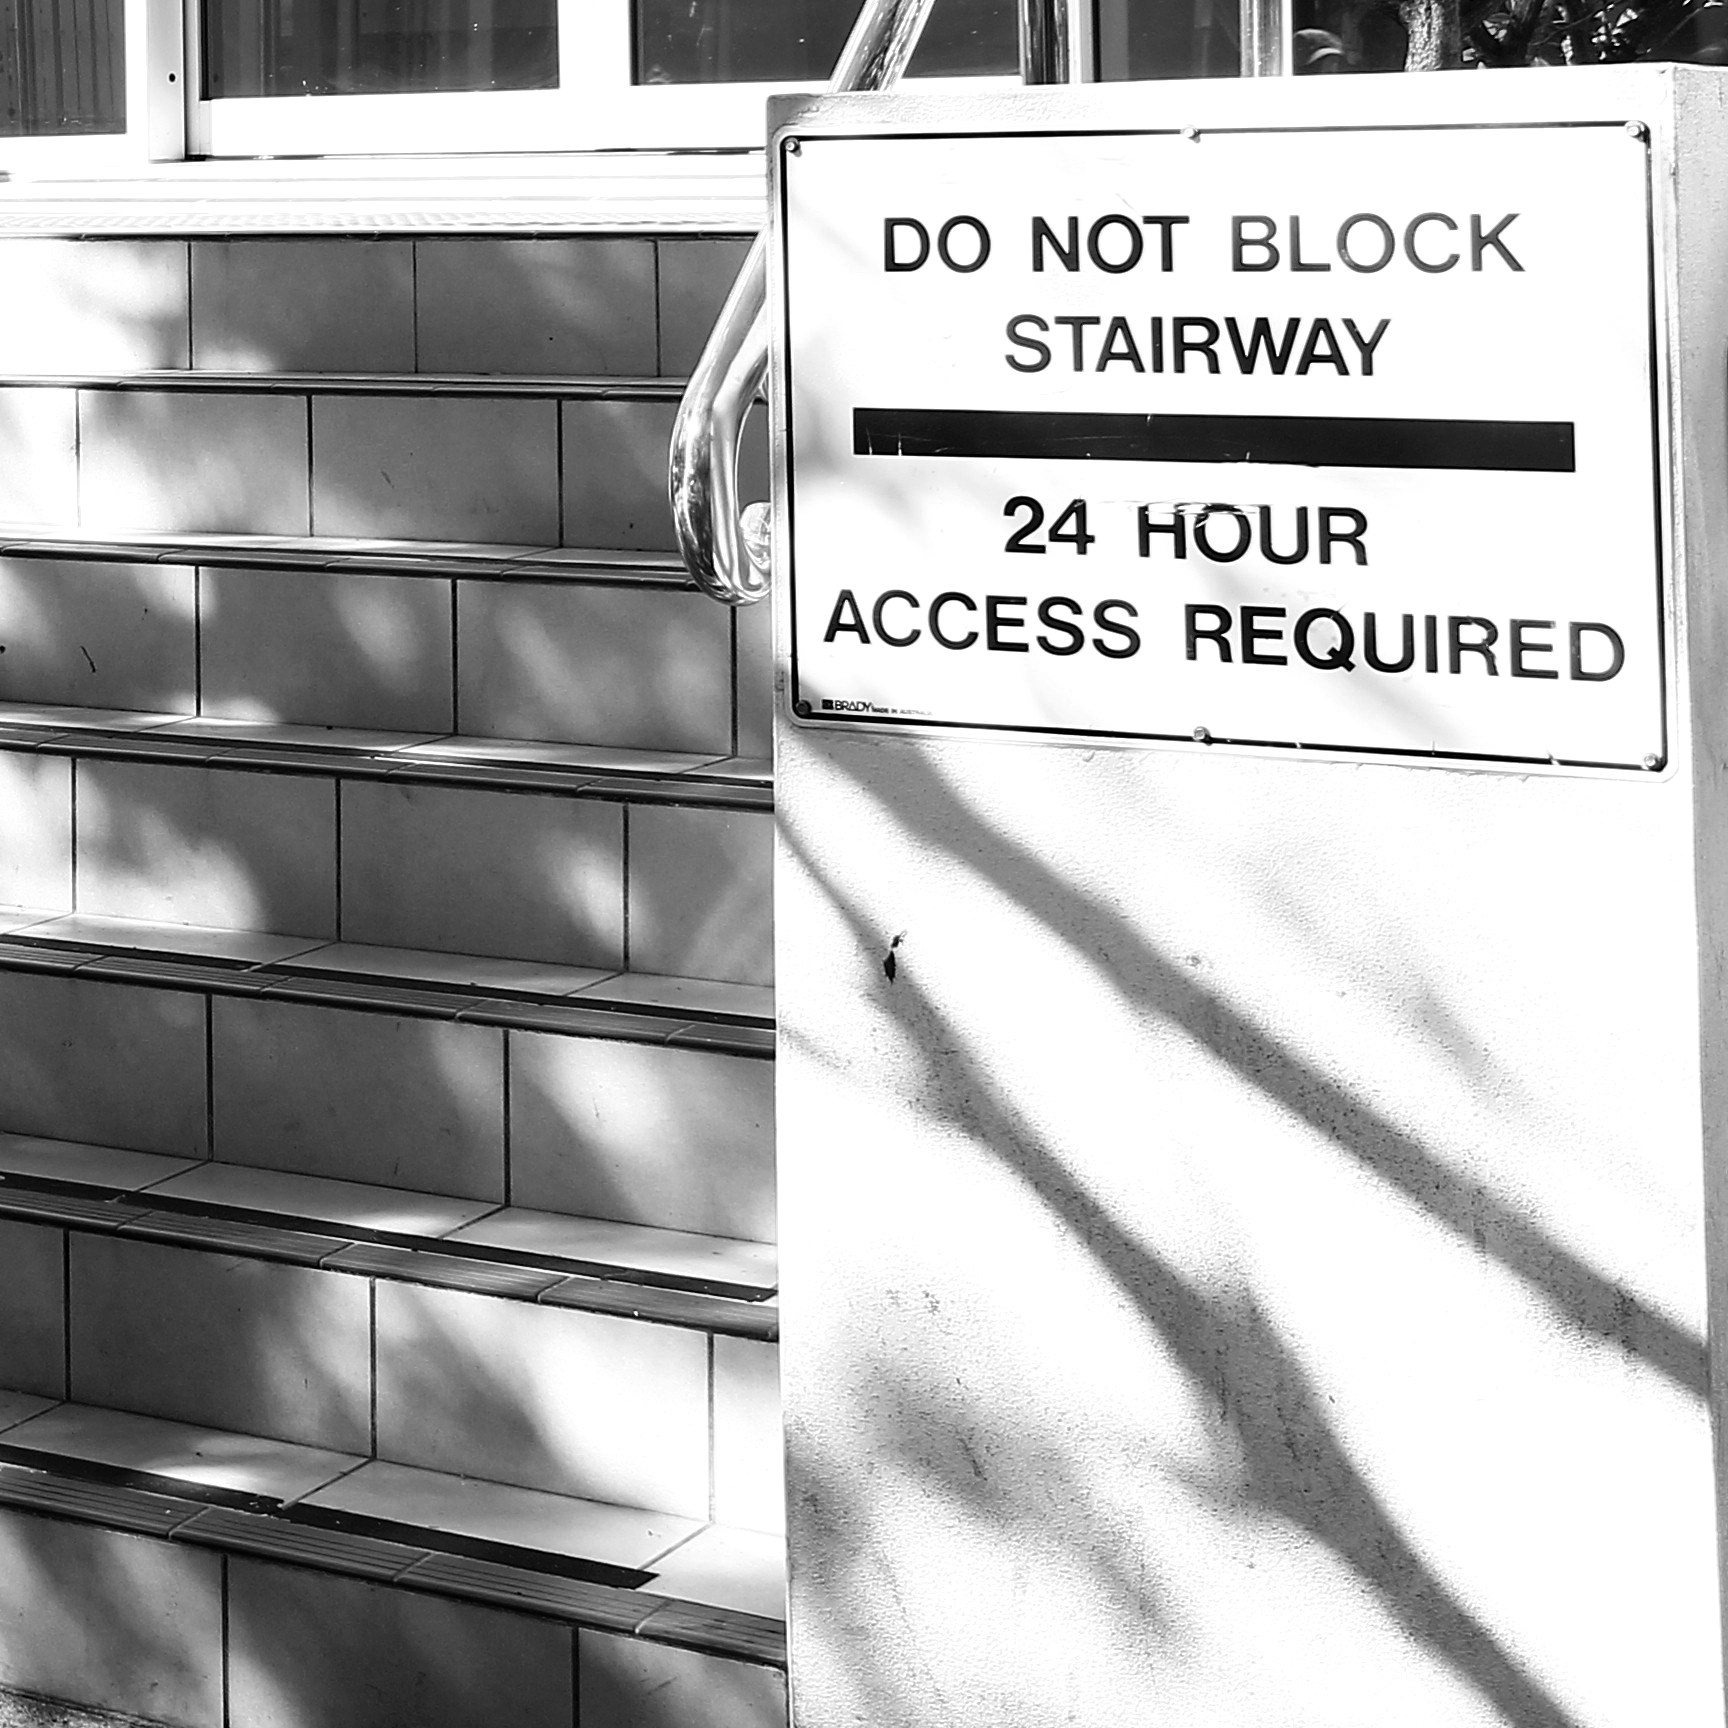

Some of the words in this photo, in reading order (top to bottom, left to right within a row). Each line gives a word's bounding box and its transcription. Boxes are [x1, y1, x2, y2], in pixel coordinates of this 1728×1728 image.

[884, 214, 992, 274] DO
[1031, 213, 1190, 275] NOT
[1232, 212, 1525, 274] BLOCK
[1005, 314, 1391, 377] STAIRWAY
[1003, 495, 1096, 556] 24
[1137, 501, 1368, 566] HOUR
[823, 589, 1142, 660] ACCESS
[1184, 603, 1625, 682] REQUIRED
[834, 700, 872, 712] BRADY
